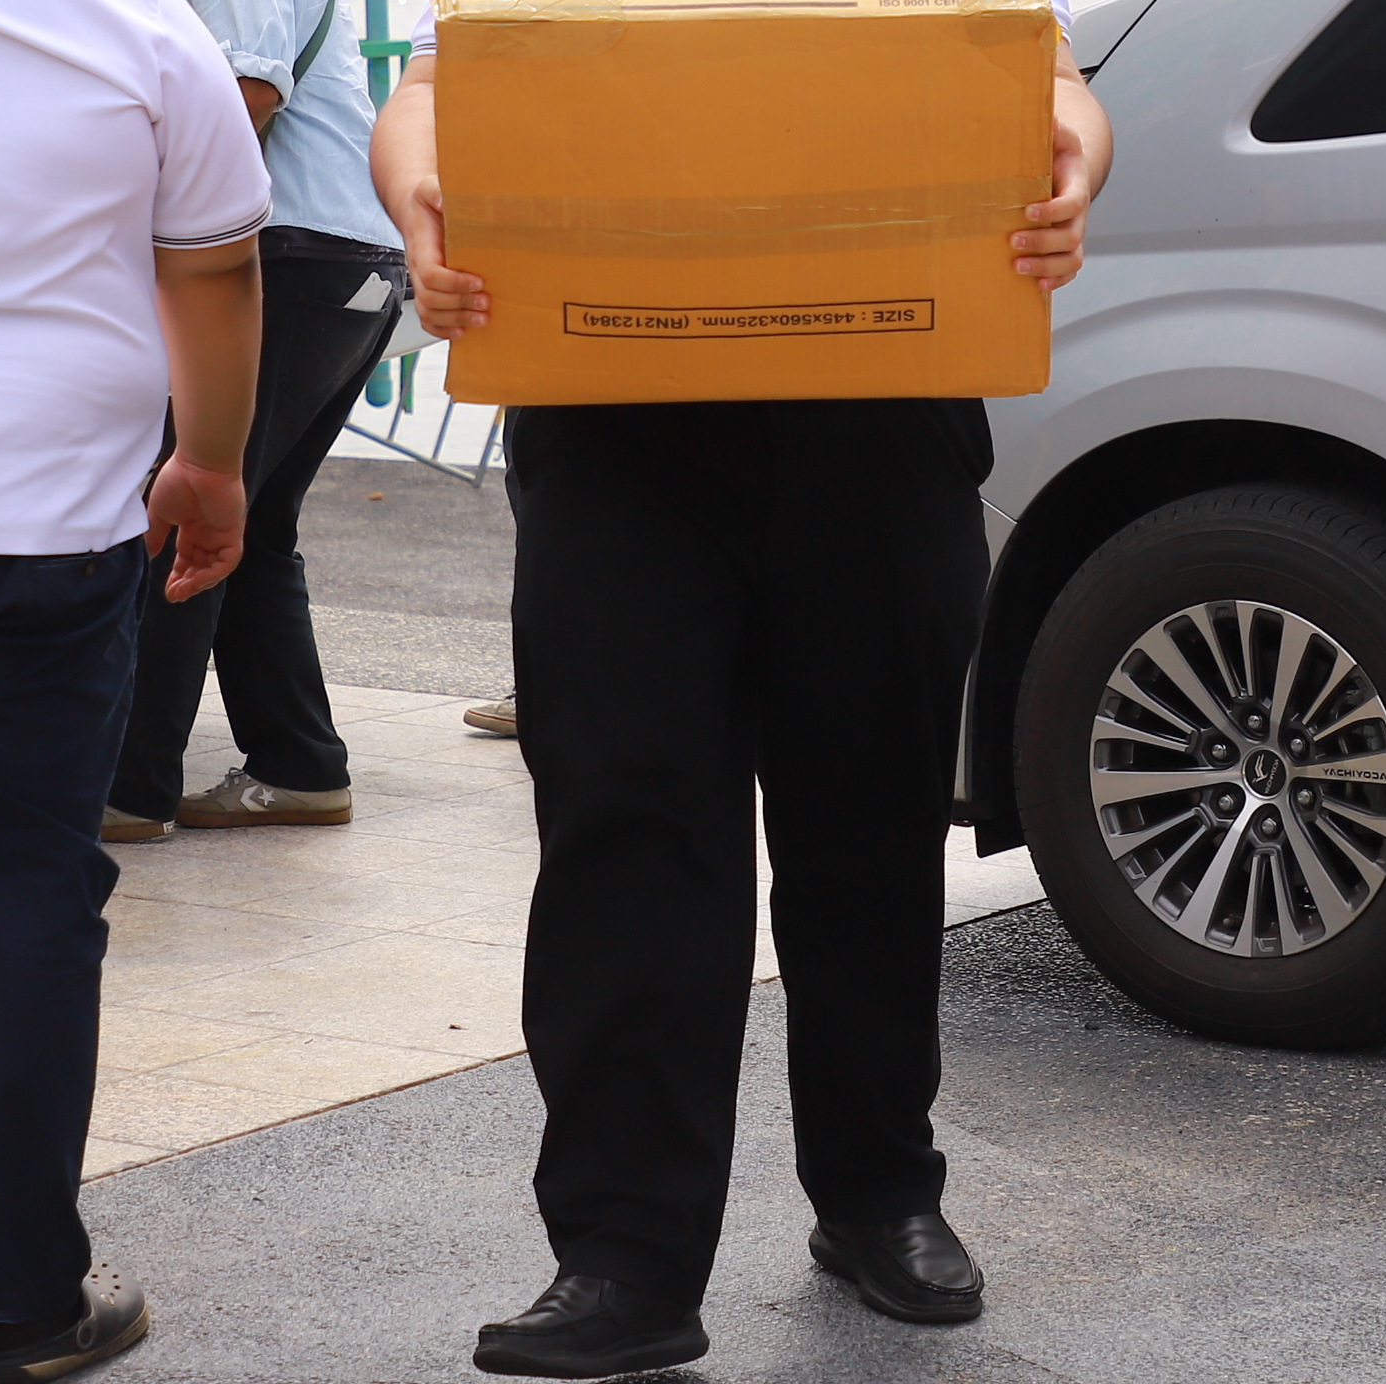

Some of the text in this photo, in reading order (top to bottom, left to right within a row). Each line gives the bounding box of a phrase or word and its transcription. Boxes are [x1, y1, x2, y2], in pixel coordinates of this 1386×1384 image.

[583, 312, 690, 329] (RN212384)
[697, 312, 856, 327] 445x560x325mm.
[872, 309, 916, 323] SIZE
